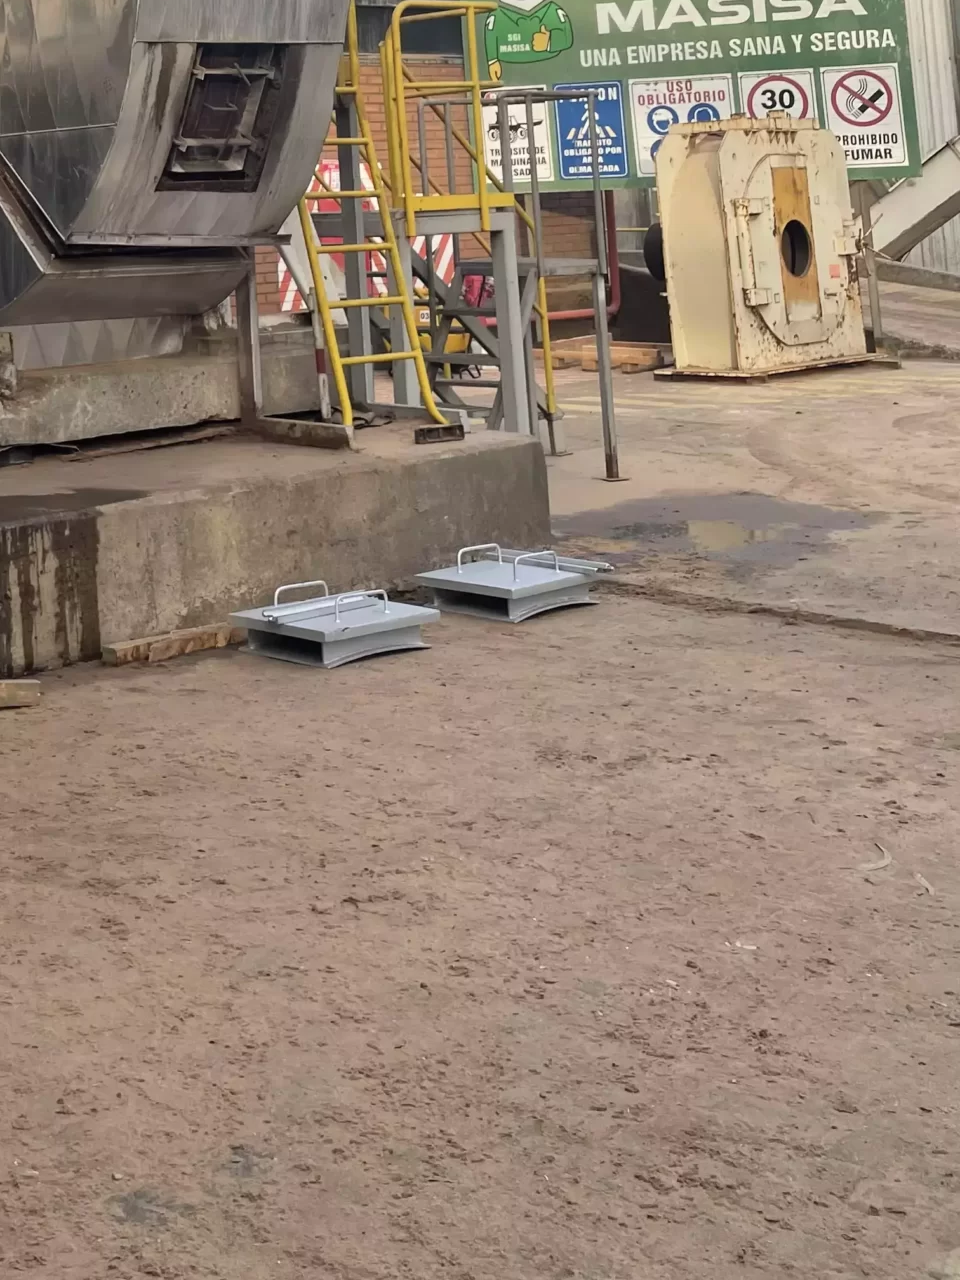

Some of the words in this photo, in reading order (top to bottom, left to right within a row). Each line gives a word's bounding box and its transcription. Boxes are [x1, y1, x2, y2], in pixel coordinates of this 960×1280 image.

[507, 33, 521, 42] SGI
[500, 43, 530, 53] MASISA
[579, 47, 621, 68] UNA
[626, 39, 724, 65] EMPRESA
[728, 35, 786, 57] SANA
[791, 33, 803, 53] Y
[810, 28, 896, 52] SEGURA
[666, 79, 694, 92] USO
[637, 89, 726, 106] OBLIGATORIO
[760, 89, 795, 109] 30
[844, 148, 893, 160] FUMAR
